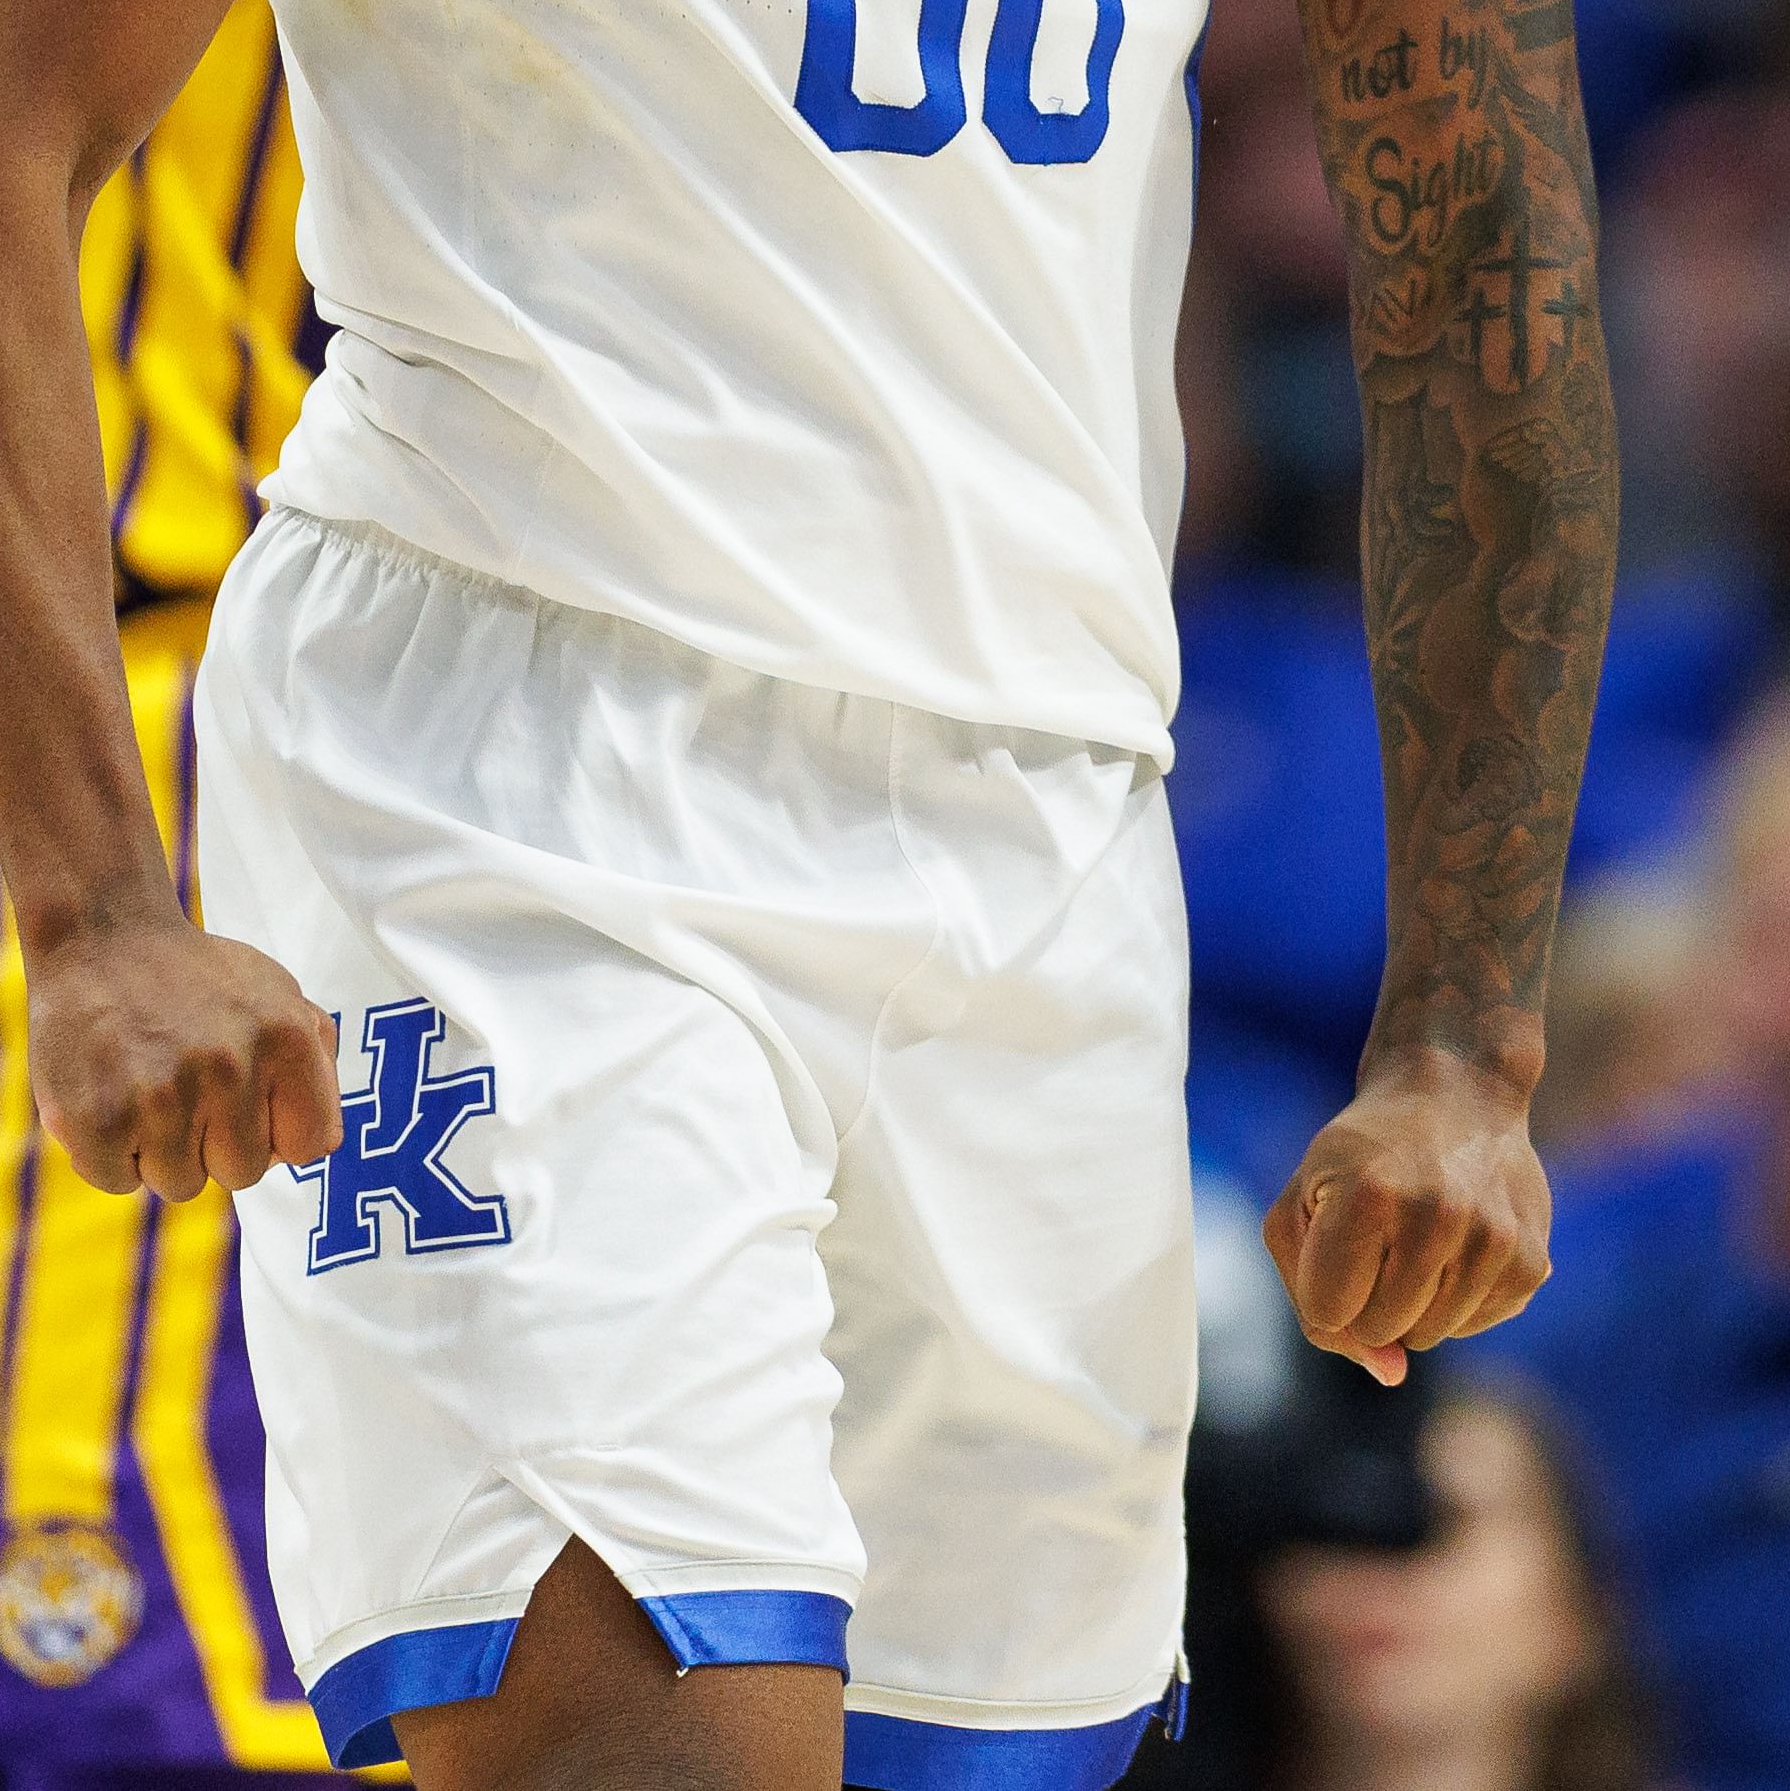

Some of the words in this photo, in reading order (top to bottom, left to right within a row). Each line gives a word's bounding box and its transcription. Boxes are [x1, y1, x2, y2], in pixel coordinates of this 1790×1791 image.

[1339, 27, 1417, 103] not
[1440, 16, 1490, 110] by
[1365, 130, 1500, 248] Sight
